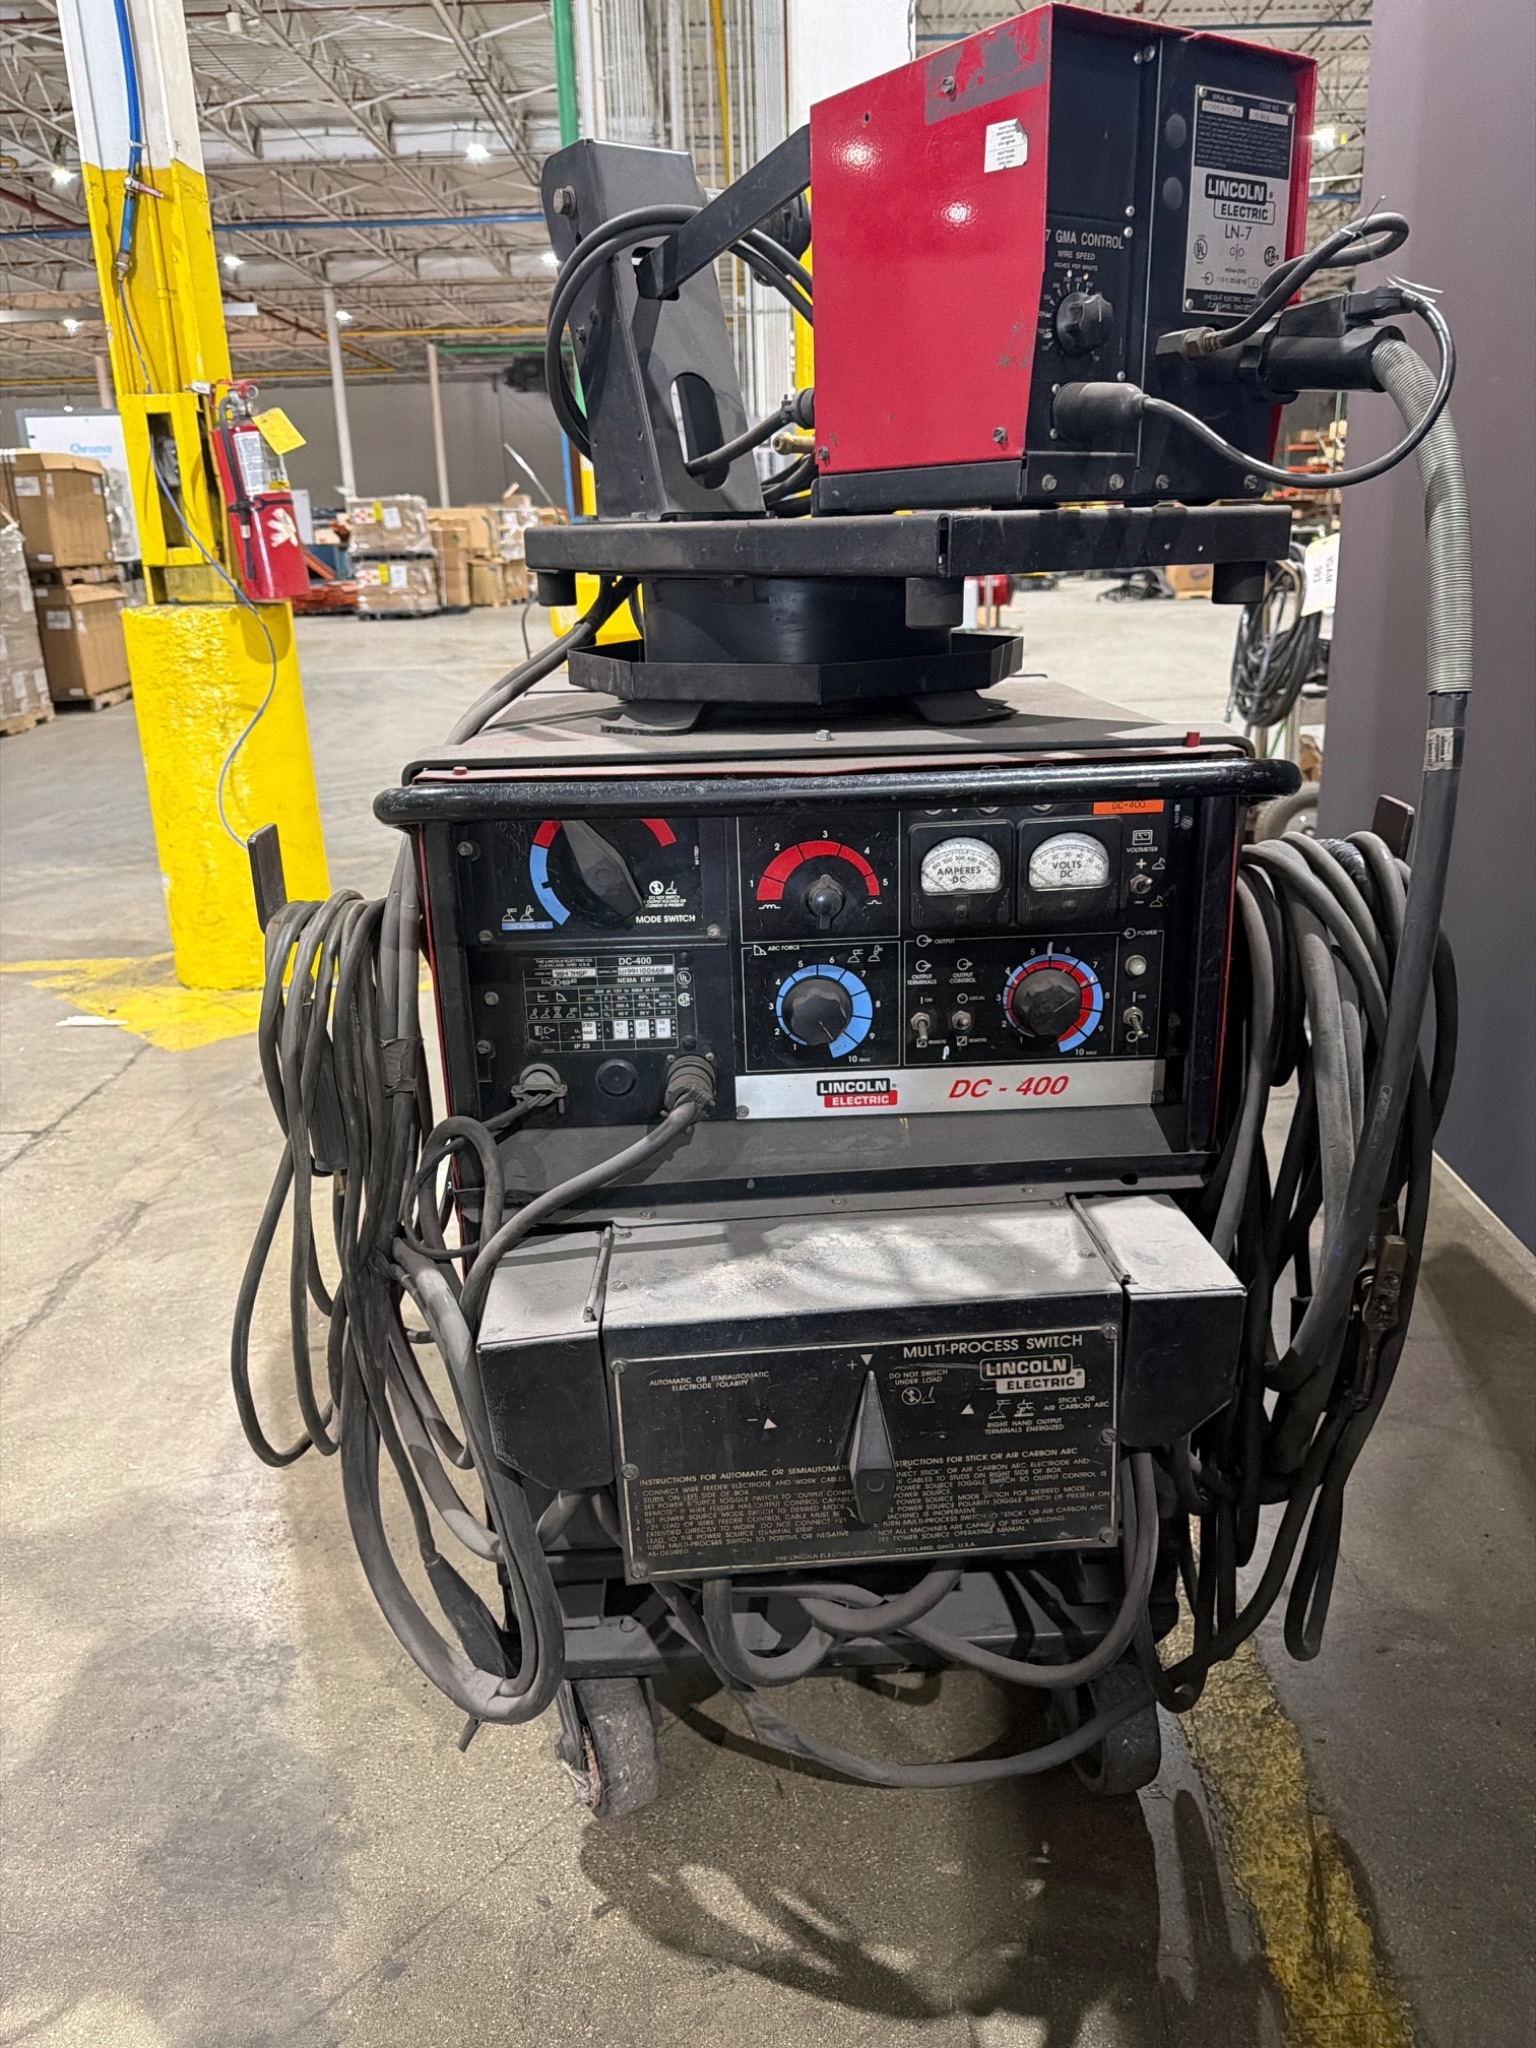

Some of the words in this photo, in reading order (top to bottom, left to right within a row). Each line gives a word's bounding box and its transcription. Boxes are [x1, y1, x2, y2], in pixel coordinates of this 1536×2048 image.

[1207, 178, 1264, 202] LINCOLN
[1221, 204, 1268, 220] ELECTRIC
[1225, 224, 1252, 241] LN-7
[1056, 230, 1076, 244] GMA
[1081, 232, 1124, 249] CONTROL
[1058, 250, 1072, 258] WIRE
[1075, 251, 1096, 260] SPEED
[937, 866, 982, 876] AMPERES
[1052, 861, 1082, 870] VOLTS
[952, 876, 968, 884] DC
[636, 916, 661, 924] MODE
[664, 915, 696, 923] SWITCH
[618, 957, 652, 965] DC-400
[820, 1081, 887, 1094] LINCOLN
[948, 1079, 992, 1098] DC
[1016, 1076, 1069, 1096] 400
[832, 1095, 889, 1106] ELECTRIC
[904, 1339, 1018, 1359] MULTI-PROCESS
[1026, 1335, 1082, 1349] SWITCH
[921, 1369, 948, 1377] SWITCH
[986, 1359, 1067, 1376] LINCOLN
[649, 1377, 692, 1387] AUTOMATIC
[711, 1371, 770, 1382] SEMIAUTOMATIC
[672, 1383, 711, 1392] ELECTRODE
[716, 1379, 749, 1388] POLARITY
[895, 1377, 918, 1385] UNDER
[1006, 1377, 1075, 1390] ELECTRIC
[1026, 1424, 1064, 1432] ENERGIZED
[895, 1457, 943, 1467] STRUCTIONS
[1021, 1448, 1057, 1457] CARBON
[1030, 1459, 1069, 1467] ELECTRODE
[639, 1475, 696, 1485] INSTRUCTIONS
[720, 1470, 767, 1479] AUTOMATIC
[642, 1487, 678, 1496] CONNECT
[732, 1480, 770, 1488] ELECTRODE
[646, 1529, 681, 1537] EXTENDED
